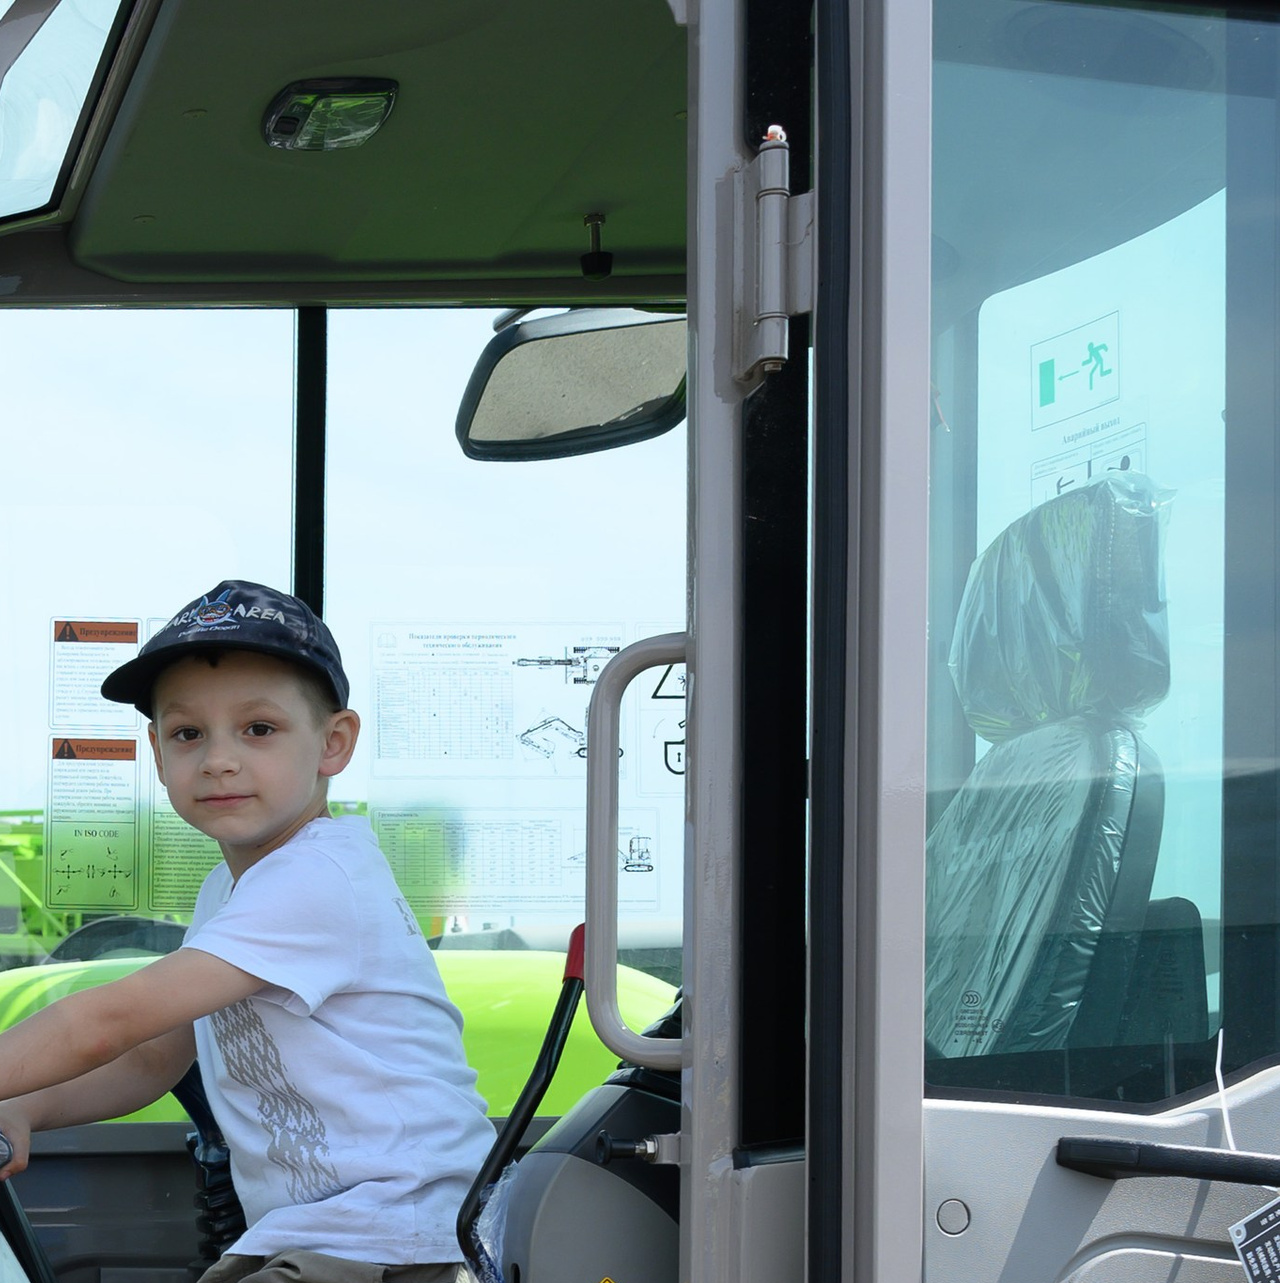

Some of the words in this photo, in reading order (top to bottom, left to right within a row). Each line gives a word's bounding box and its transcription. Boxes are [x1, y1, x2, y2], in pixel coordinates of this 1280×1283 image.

[233, 603, 286, 625] AREA
[84, 829, 97, 838] ISO
[98, 829, 119, 838] CODE
